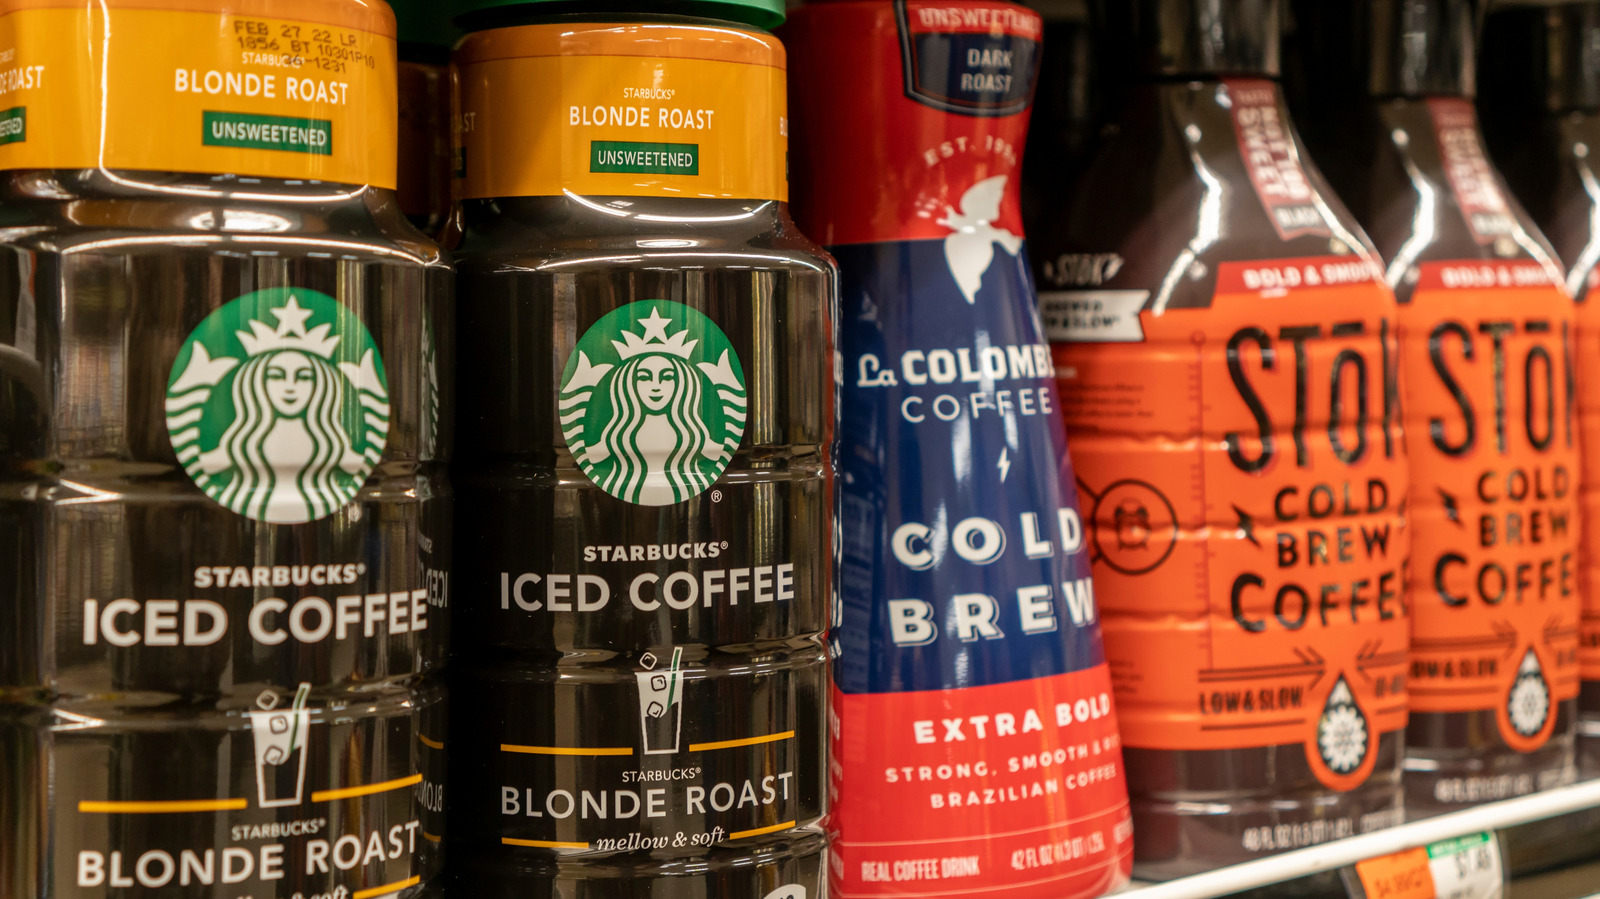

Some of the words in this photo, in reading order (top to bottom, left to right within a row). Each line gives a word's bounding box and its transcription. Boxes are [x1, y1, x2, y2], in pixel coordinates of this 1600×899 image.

[233, 20, 268, 36] FEB
[280, 25, 301, 38] 27
[312, 29, 332, 44] 22
[967, 49, 1013, 67] DARK
[174, 69, 276, 99] BLONDE
[286, 78, 349, 106] ROAST
[961, 73, 1013, 92] ROAST
[212, 121, 328, 148] UNSWEETENED
[569, 105, 651, 128] BLONDE
[657, 107, 715, 130] ROAST
[598, 150, 694, 168] UNSWEETENED
[1242, 266, 1301, 289] BOLD
[1303, 265, 1322, 286] &
[857, 353, 898, 387] La
[901, 387, 1053, 423] COFFEE
[1274, 478, 1390, 522] COLD
[1477, 465, 1570, 504] COLD
[891, 507, 1083, 571] COLD
[1276, 524, 1390, 568] BREW
[1478, 508, 1570, 548] BREW
[500, 572, 611, 613] ICED
[629, 563, 795, 612] COFFEE
[1434, 552, 1572, 607] COFFE
[82, 598, 229, 647] ICED
[248, 588, 428, 645] COFFEE
[888, 577, 1096, 647] BREW
[913, 708, 1043, 744] EXTRA
[1055, 693, 1111, 727] BOLD
[1200, 690, 1240, 714] LOW
[1243, 690, 1254, 712] &
[1259, 686, 1304, 712] SLOW
[885, 761, 997, 783] STRONG,
[1008, 743, 1088, 772] SMOOTH
[501, 786, 667, 820] BLONDE
[686, 771, 793, 815] ROAST
[930, 778, 1058, 809] BRAZILIAN
[1065, 762, 1116, 790] COFFEE
[77, 844, 285, 888] BLONDE
[305, 820, 420, 875] ROAST
[596, 833, 669, 852] mellow
[671, 831, 687, 848] &
[690, 826, 725, 848] soft
[861, 860, 892, 882] REAL
[893, 858, 940, 881] COFFEE
[941, 856, 981, 878] DRINK
